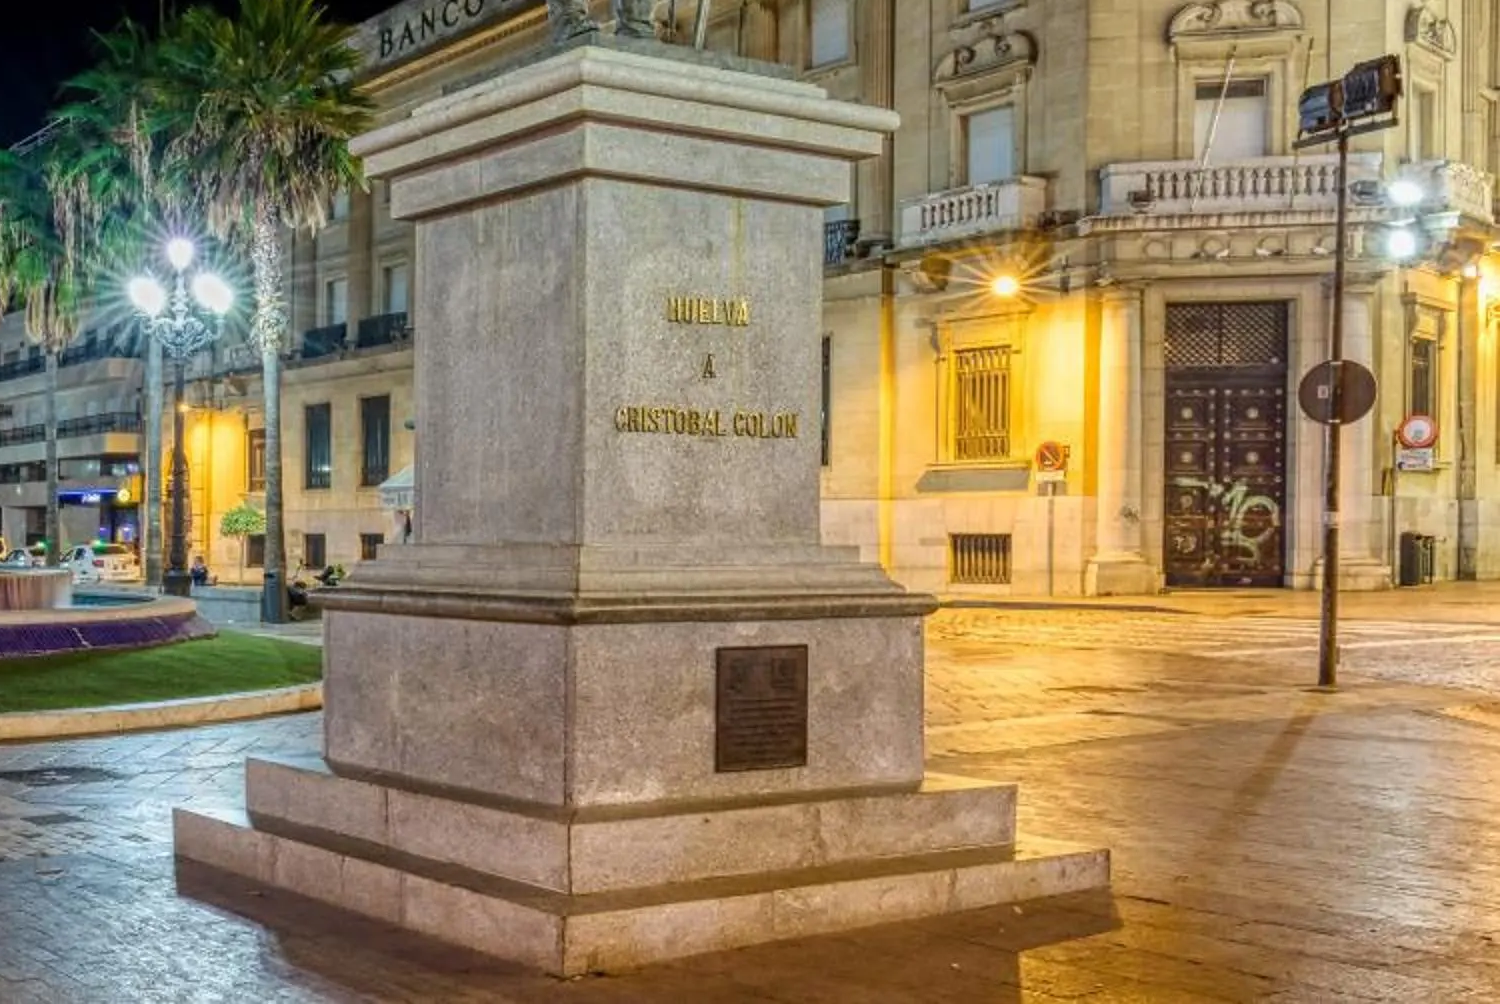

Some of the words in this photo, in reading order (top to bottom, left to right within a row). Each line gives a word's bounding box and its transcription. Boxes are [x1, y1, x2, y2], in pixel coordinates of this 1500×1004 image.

[666, 297, 749, 326] HUELVA
[702, 353, 716, 378] A
[615, 405, 726, 436] CRISTOBAL
[733, 411, 799, 438] COLON
